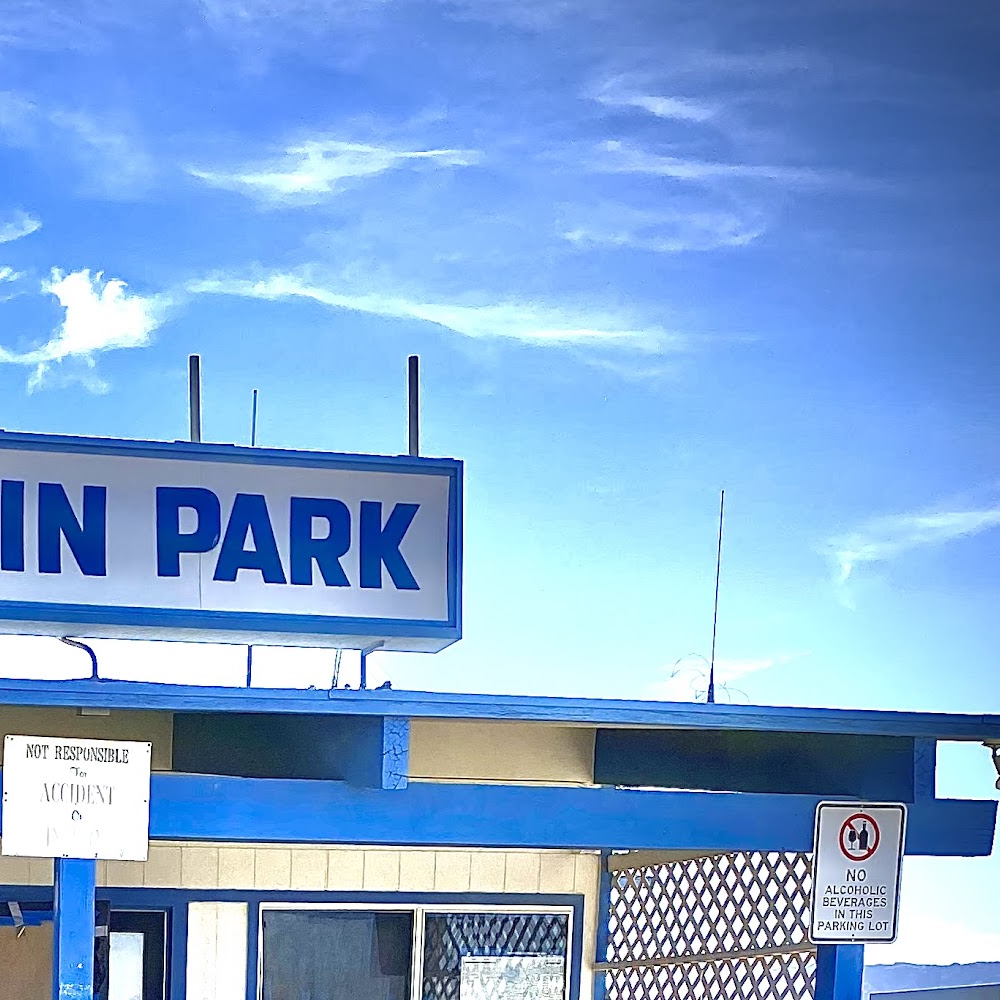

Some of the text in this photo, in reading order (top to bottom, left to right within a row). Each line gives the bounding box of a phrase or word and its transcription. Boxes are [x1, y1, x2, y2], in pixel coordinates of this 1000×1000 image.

[156, 486, 421, 590] PARK
[26, 743, 129, 764] NOT RESPONSIBLE
[40, 782, 116, 805] ACCIDENT
[846, 868, 867, 882] NO
[824, 885, 887, 896] ALCOHOLIC
[822, 897, 887, 908] BEVERAGES
[834, 909, 873, 919] IN THIS
[817, 921, 889, 931] PARKING LOT
